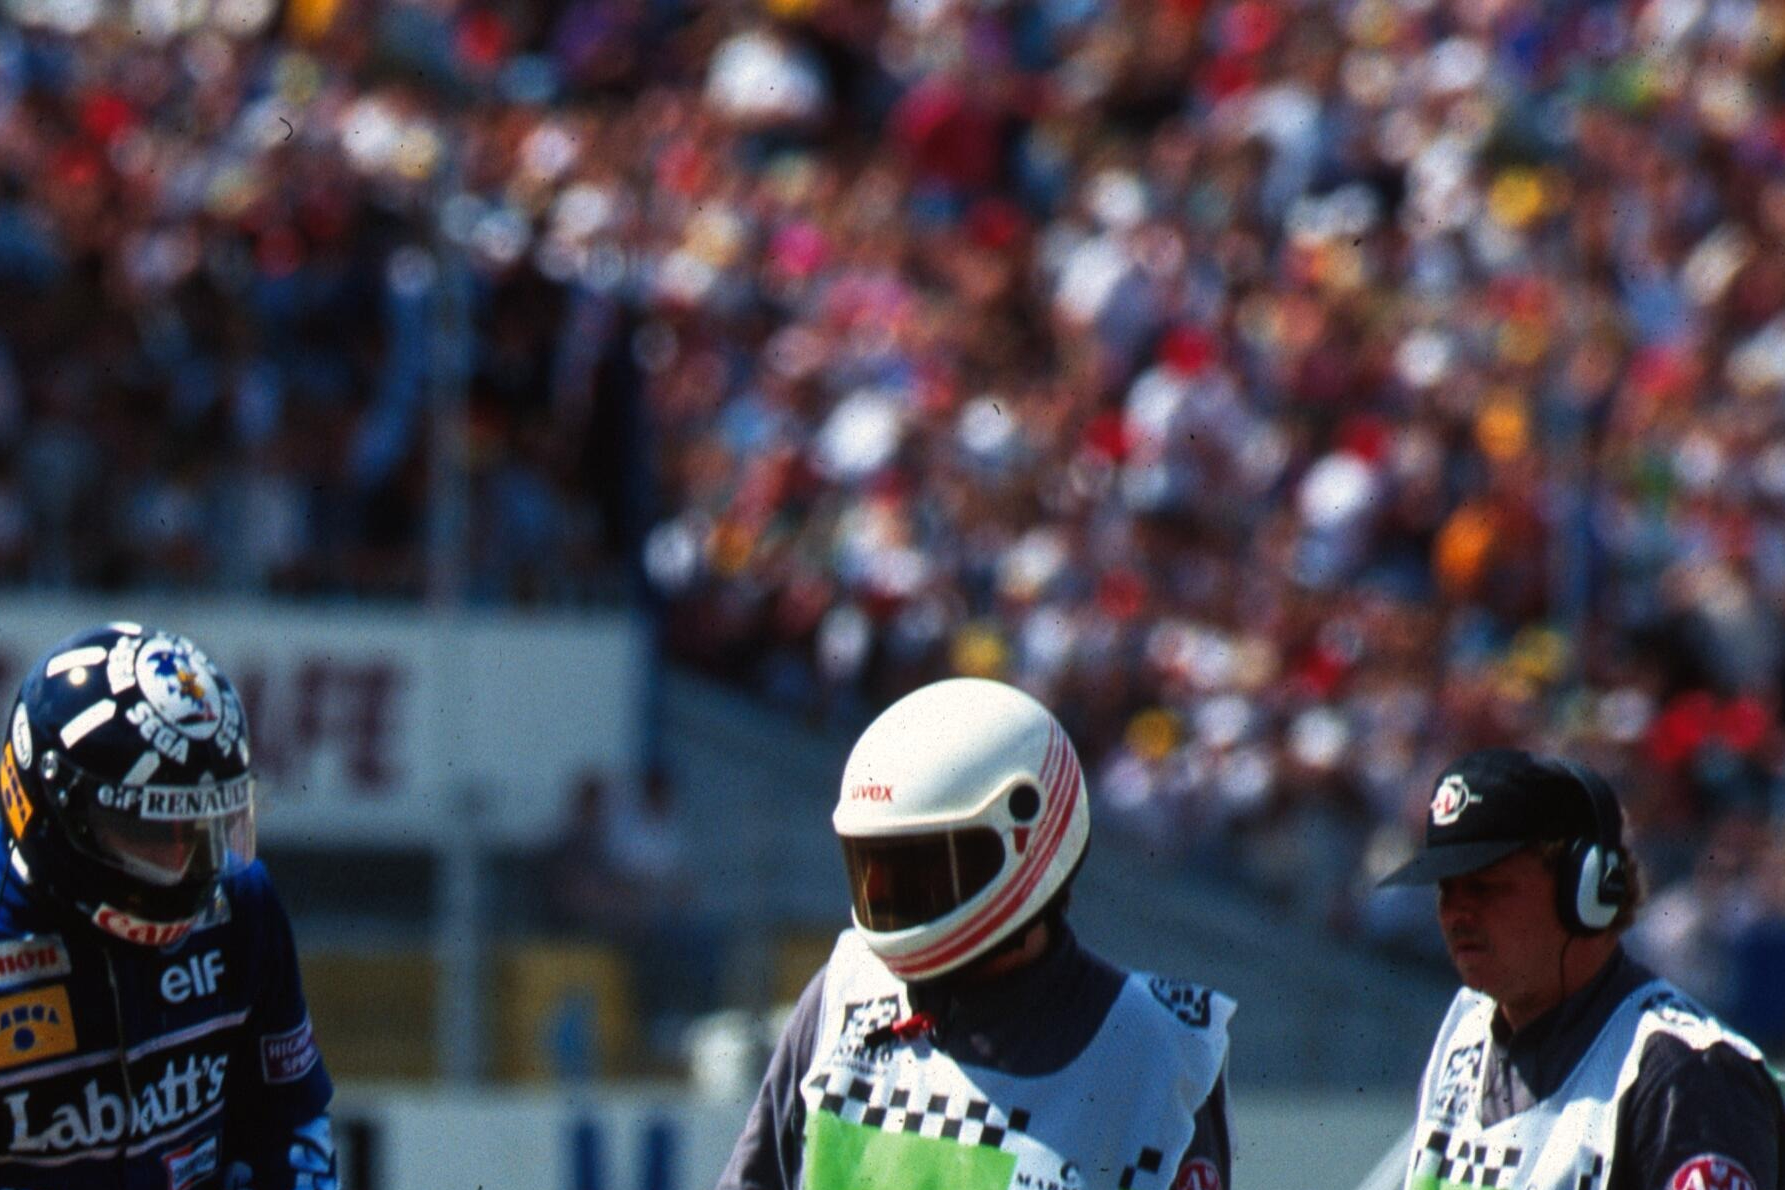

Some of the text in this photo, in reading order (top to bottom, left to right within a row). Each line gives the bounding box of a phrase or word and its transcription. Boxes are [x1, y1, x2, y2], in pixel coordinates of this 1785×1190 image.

[126, 701, 189, 764] SEGA
[161, 949, 226, 1003] elf
[6, 1053, 227, 1152] Labatt's
